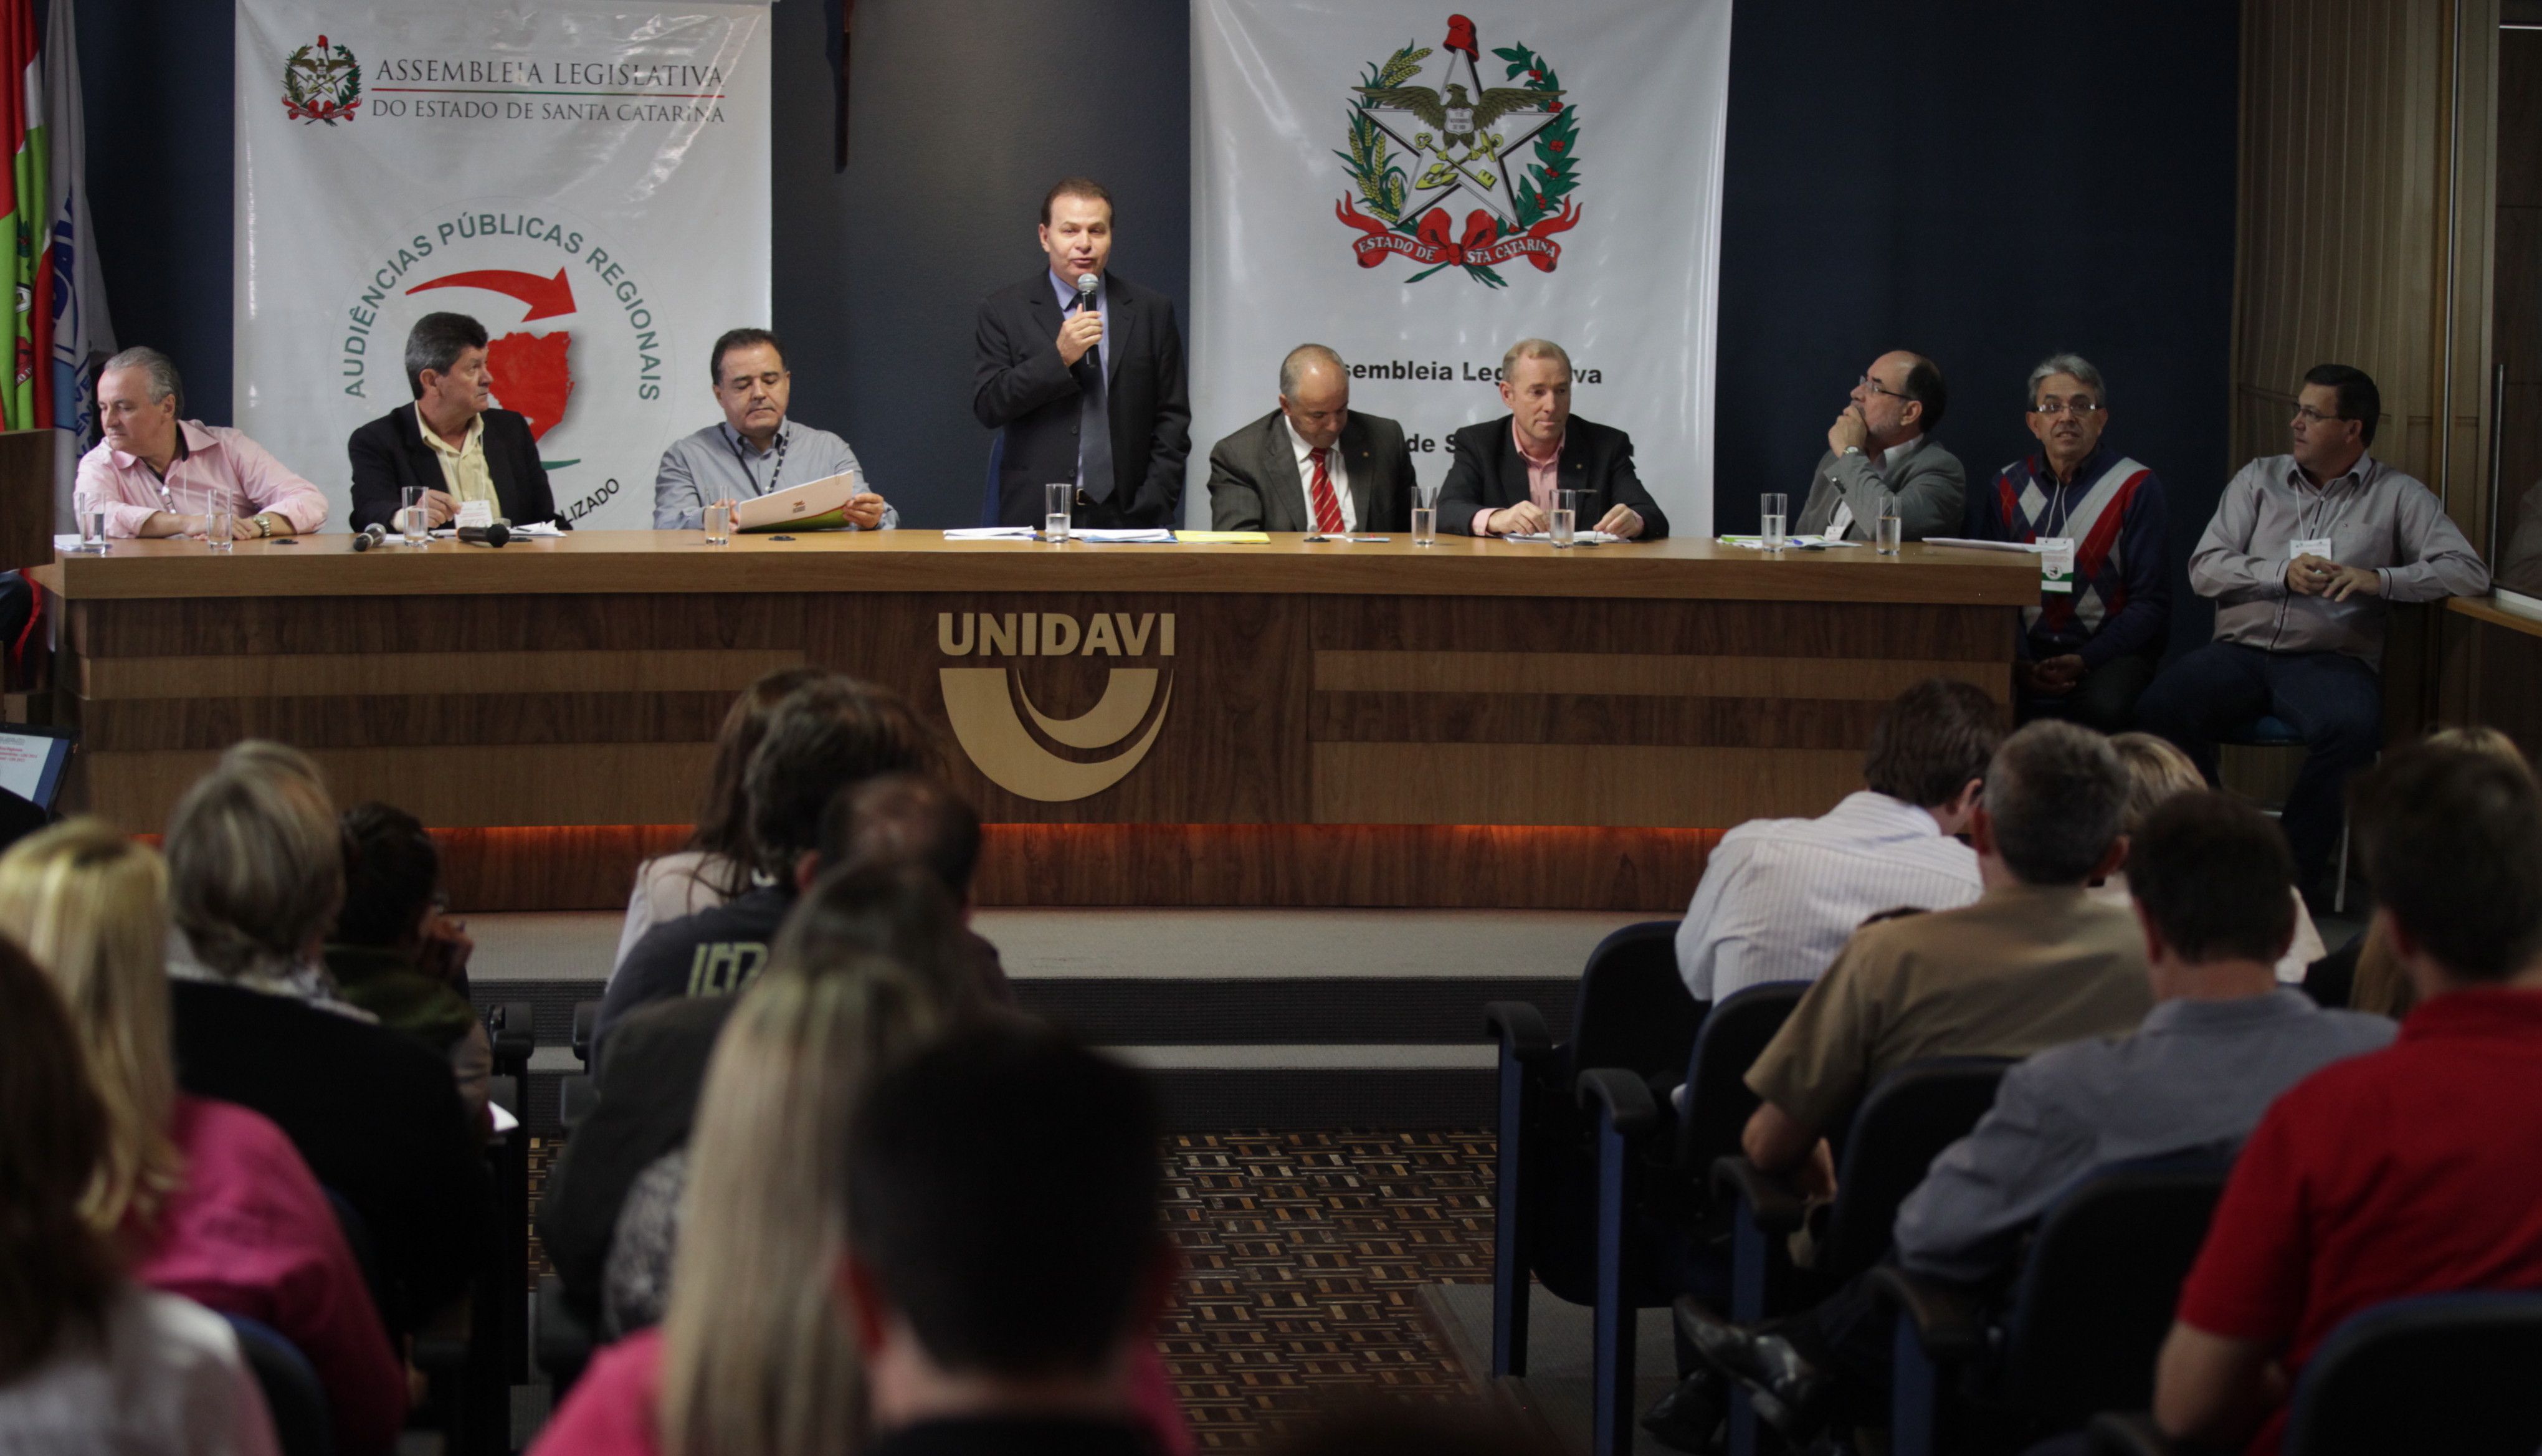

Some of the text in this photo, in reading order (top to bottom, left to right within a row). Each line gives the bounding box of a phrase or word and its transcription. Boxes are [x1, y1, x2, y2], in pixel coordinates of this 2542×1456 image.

[376, 59, 725, 87] ASSEMBLEIA LEGISLATIVA
[373, 100, 406, 117] DO
[416, 100, 498, 118] ESTADO
[507, 102, 533, 119] DE
[542, 103, 610, 120] SANTA
[617, 105, 725, 122] CATARINA
[1358, 236, 1414, 254] ESTADO
[1415, 245, 1435, 261] DE
[1495, 238, 1556, 258] CATARINA
[343, 212, 662, 401] AUDIÊNCIAS PÚBLICAS REGIONAIS
[938, 612, 1176, 657] UNIDAVI
